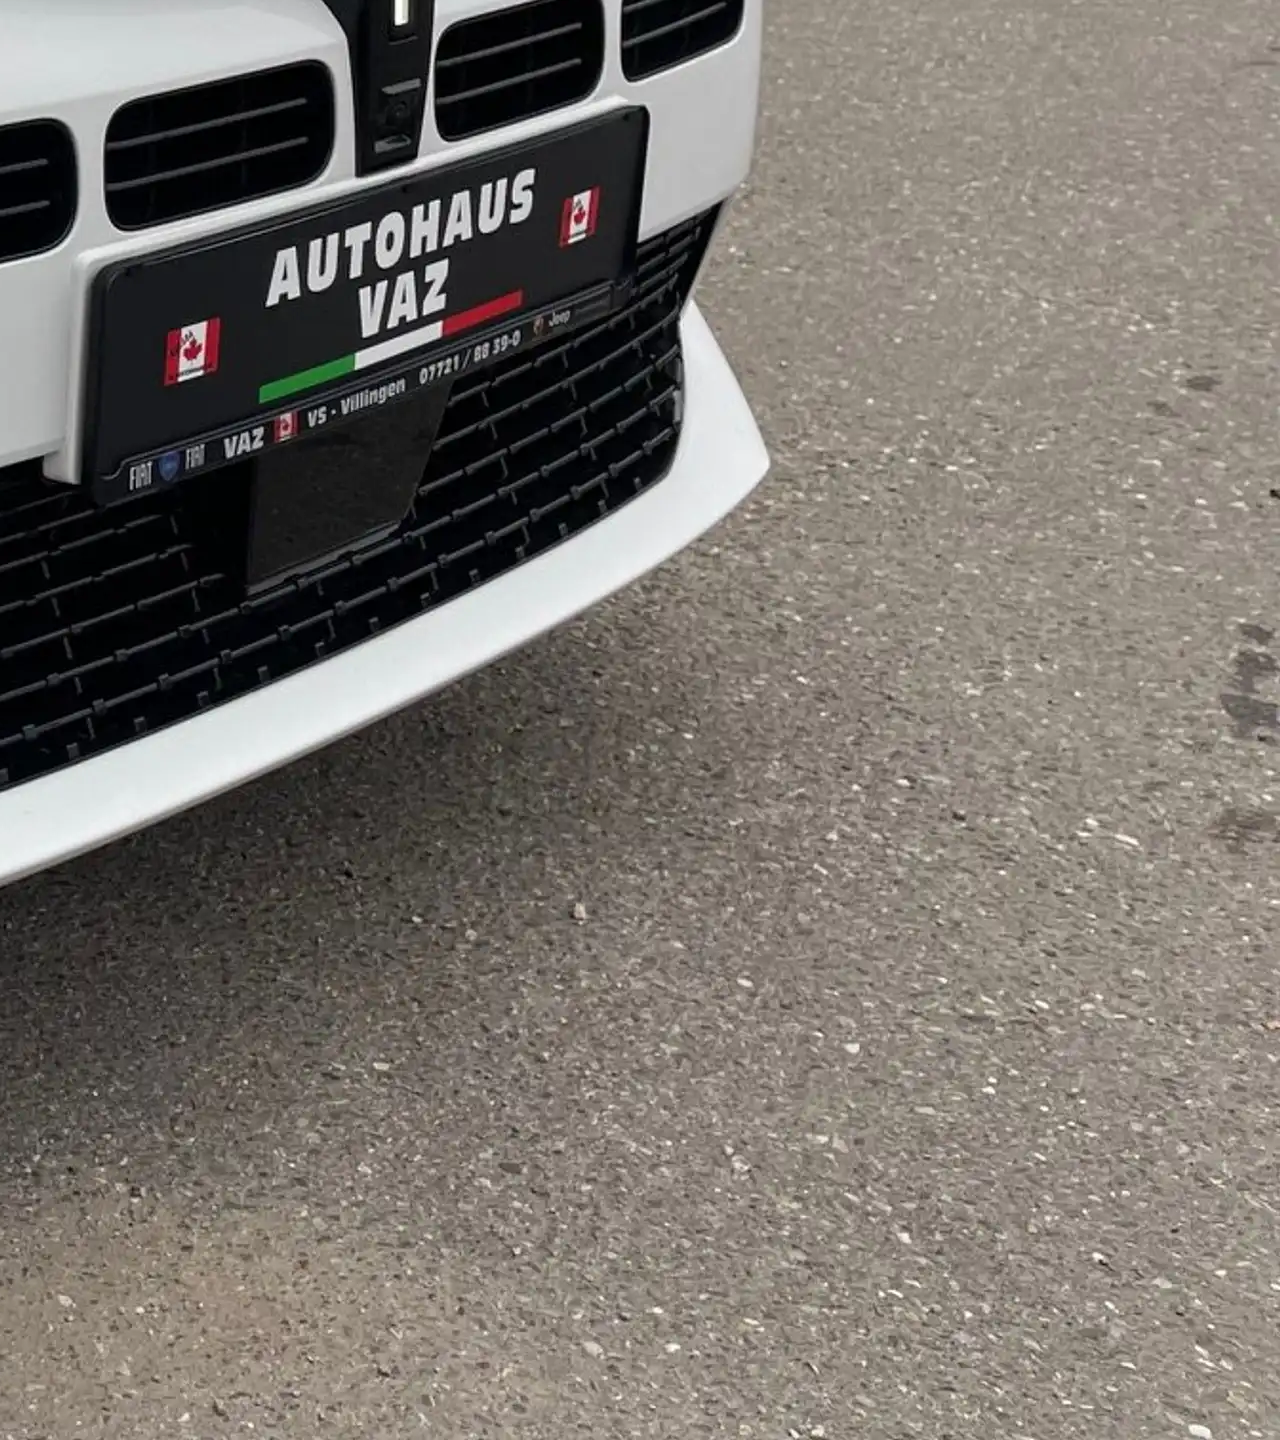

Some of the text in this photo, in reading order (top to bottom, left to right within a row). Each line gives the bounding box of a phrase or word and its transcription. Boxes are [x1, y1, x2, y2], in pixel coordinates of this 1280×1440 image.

[264, 168, 536, 308] AUTOHAUS
[358, 258, 450, 339] VAZ
[549, 311, 570, 327] Jeep
[307, 406, 328, 428] VS
[340, 377, 407, 415] Villingen
[418, 354, 460, 385] 07721
[492, 329, 522, 355] 39-0
[224, 426, 264, 459] VAZ
[129, 461, 153, 492] FIAT
